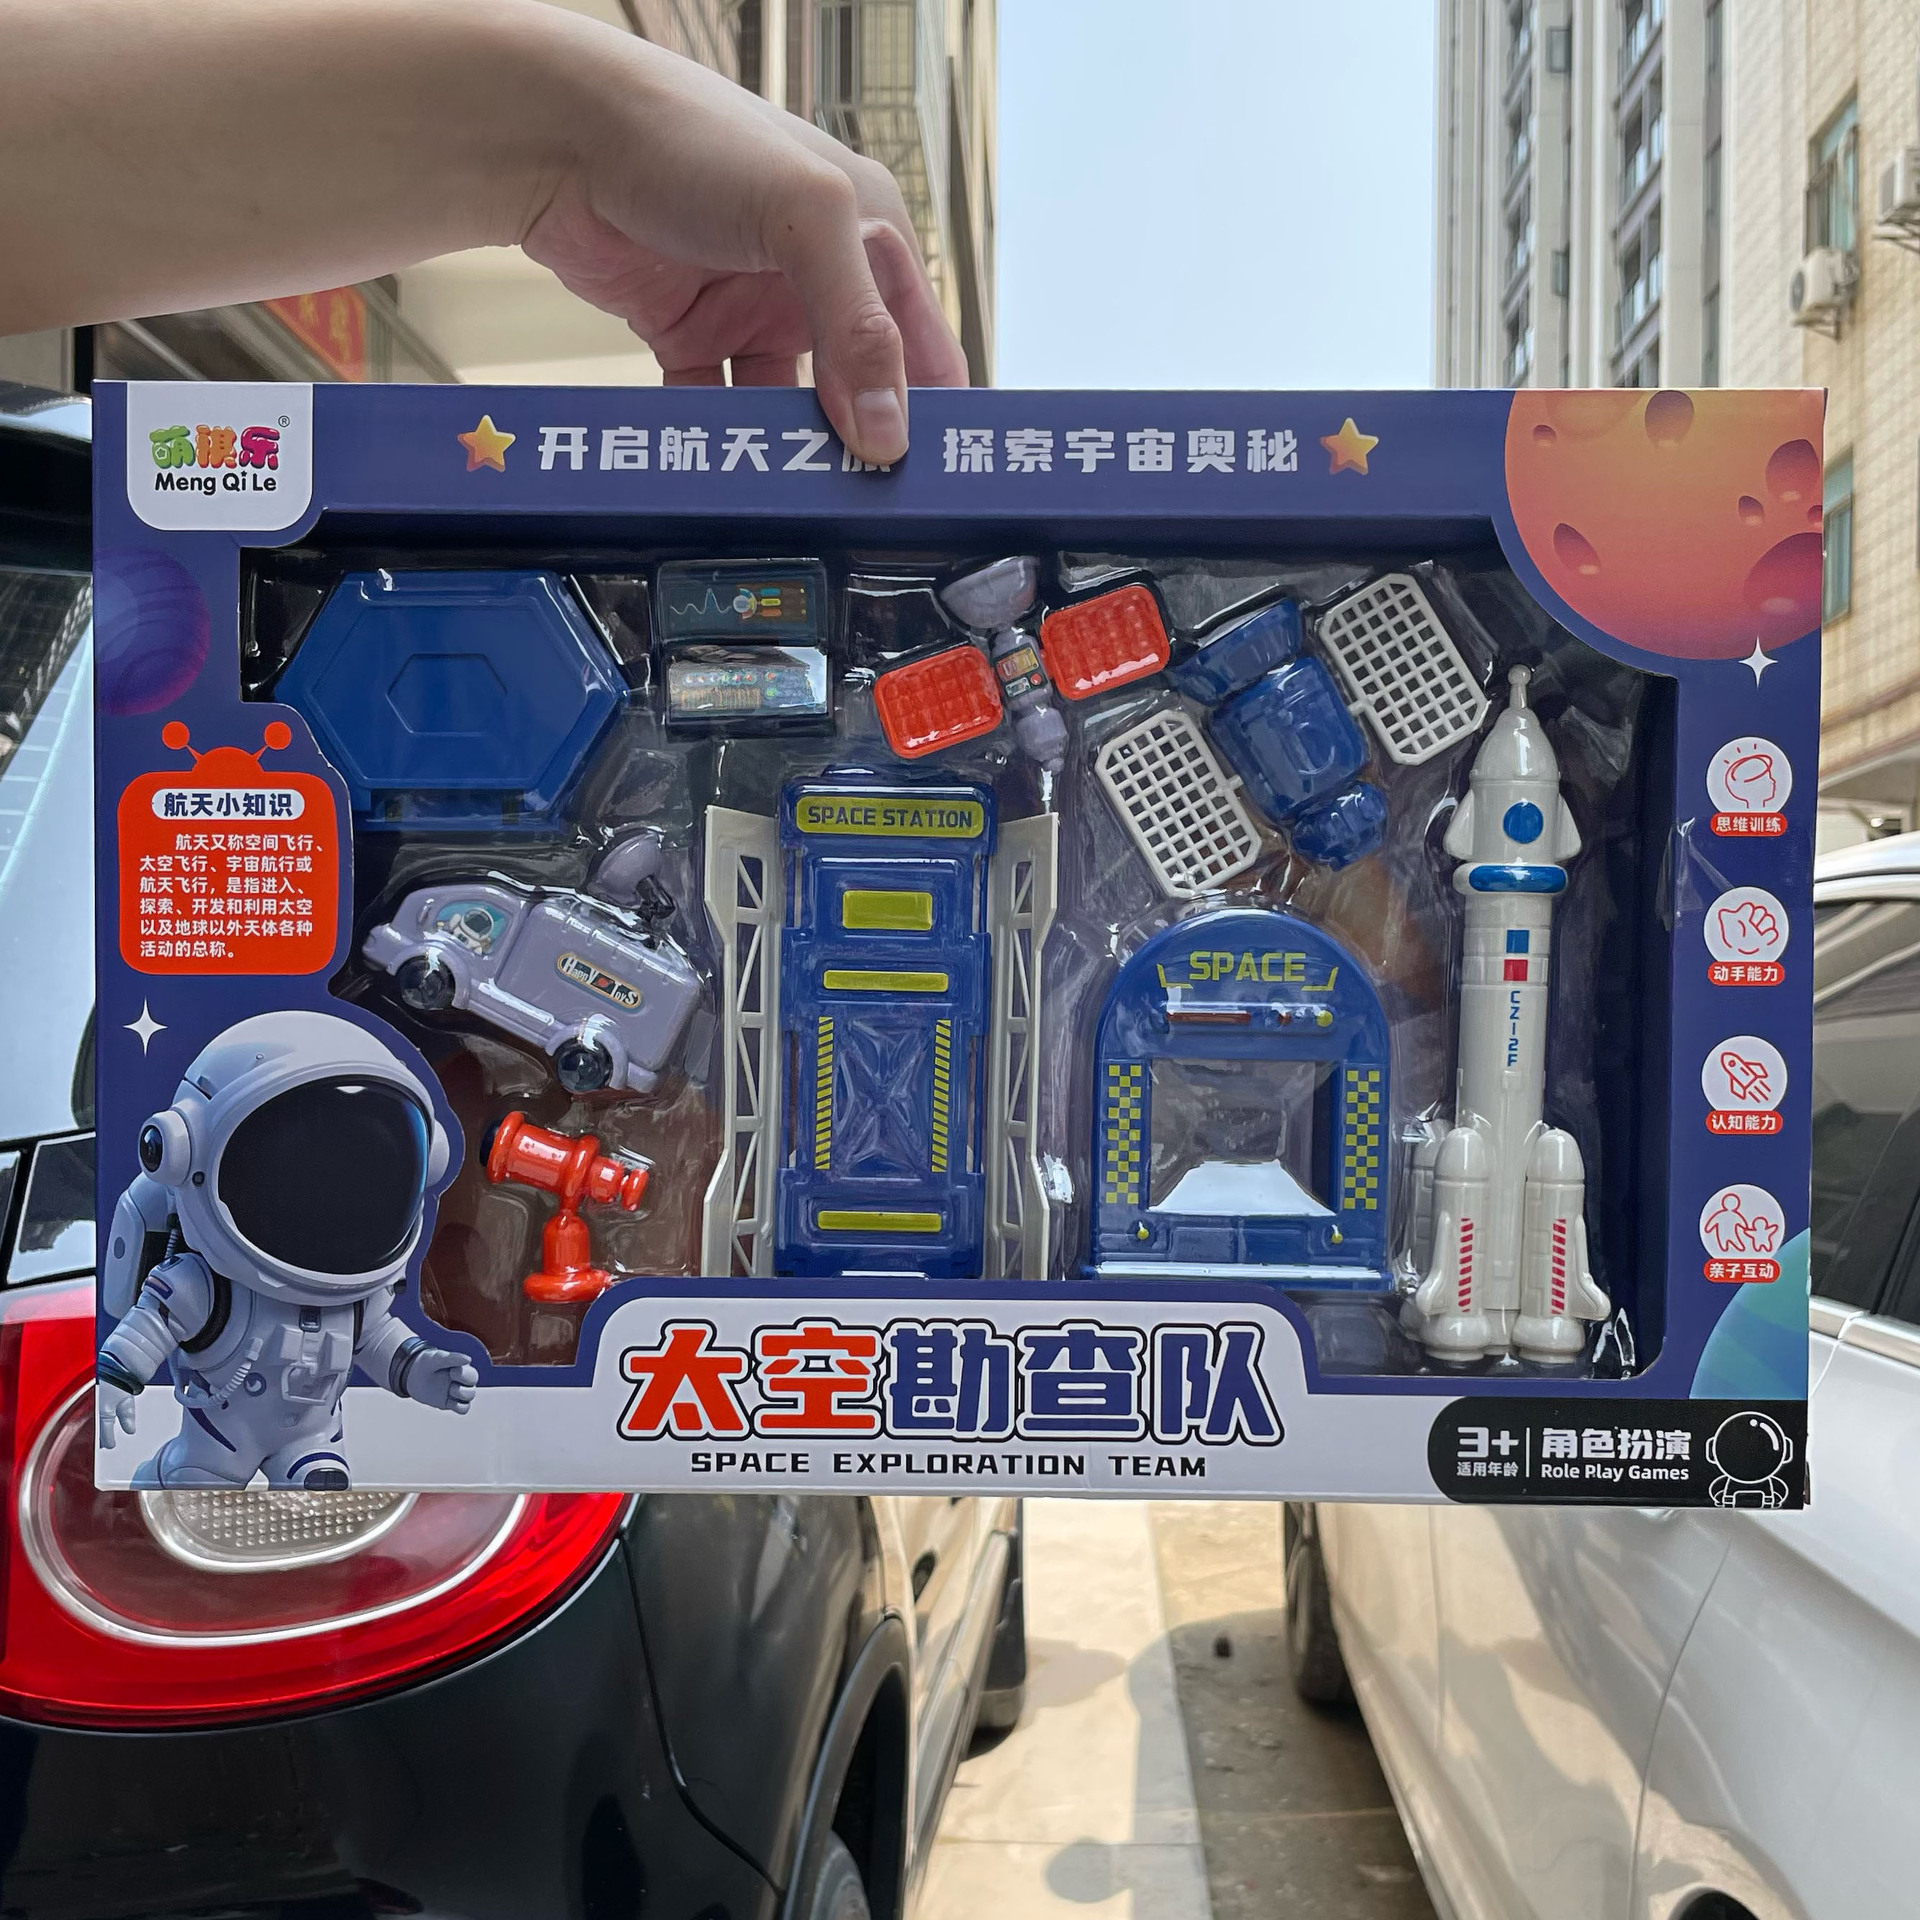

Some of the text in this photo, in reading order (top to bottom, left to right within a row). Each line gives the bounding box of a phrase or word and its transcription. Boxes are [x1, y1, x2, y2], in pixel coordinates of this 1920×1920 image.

[538, 426, 1298, 473] 开启航天之 探索宇宙奥秘
[155, 470, 277, 496] Meng Qi Le
[164, 792, 293, 817] 航天小知识
[808, 805, 972, 828] SPACE STATION
[1716, 816, 1782, 833] 思维训练
[139, 919, 313, 937] 以及地球以外天体各种
[1189, 950, 1306, 982] SPACE
[1713, 965, 1778, 982] 动手能力
[1711, 1114, 1776, 1131] 认知能力
[1709, 1262, 1774, 1279] 亲子互动
[617, 1317, 1284, 1446] 太空勘查队
[1457, 1426, 1519, 1458] 3+
[1541, 1427, 1692, 1460] 角色扮演
[691, 1452, 1206, 1477] SPACE EXPLORATION TEAM
[1456, 1461, 1519, 1477] 适用年龄
[1541, 1463, 1690, 1482] Role Play Games
